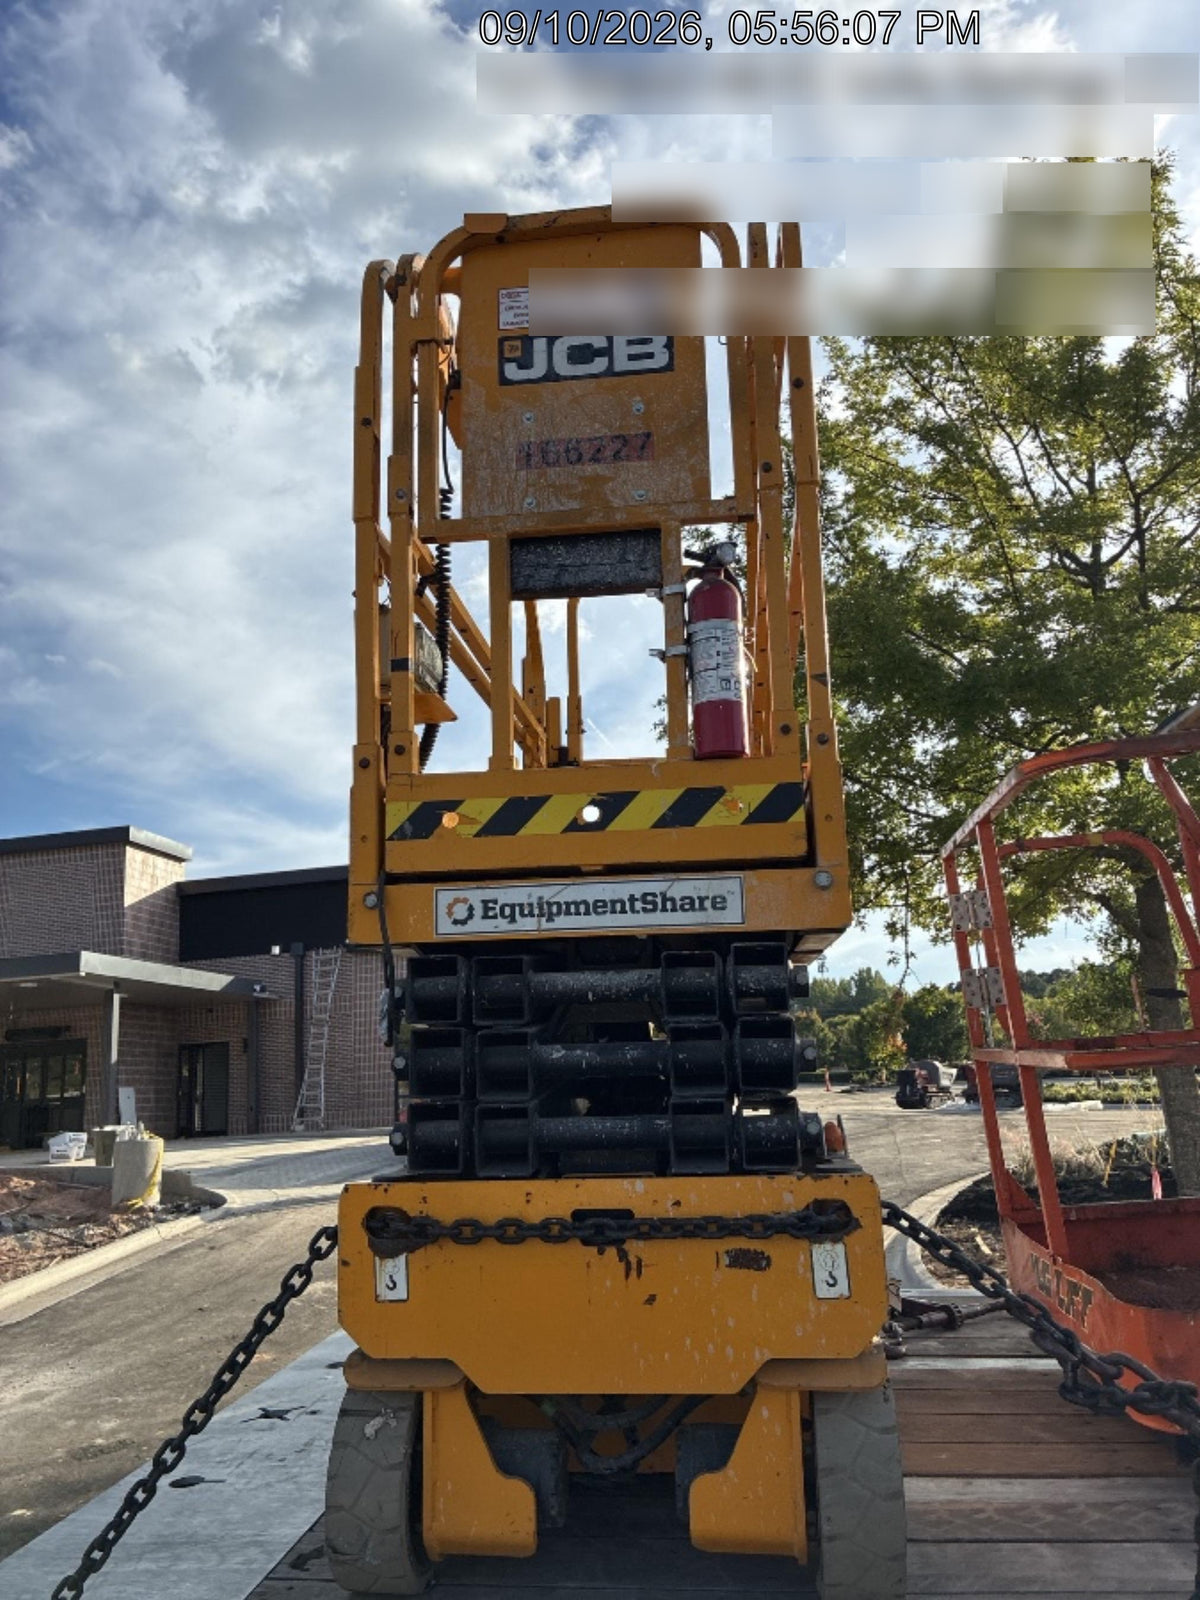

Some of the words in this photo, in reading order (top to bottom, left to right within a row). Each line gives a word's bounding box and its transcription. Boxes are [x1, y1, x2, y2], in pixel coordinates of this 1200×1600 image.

[503, 335, 670, 382] JCB
[519, 432, 652, 468] 166227
[480, 891, 728, 925] EquipmentShare
